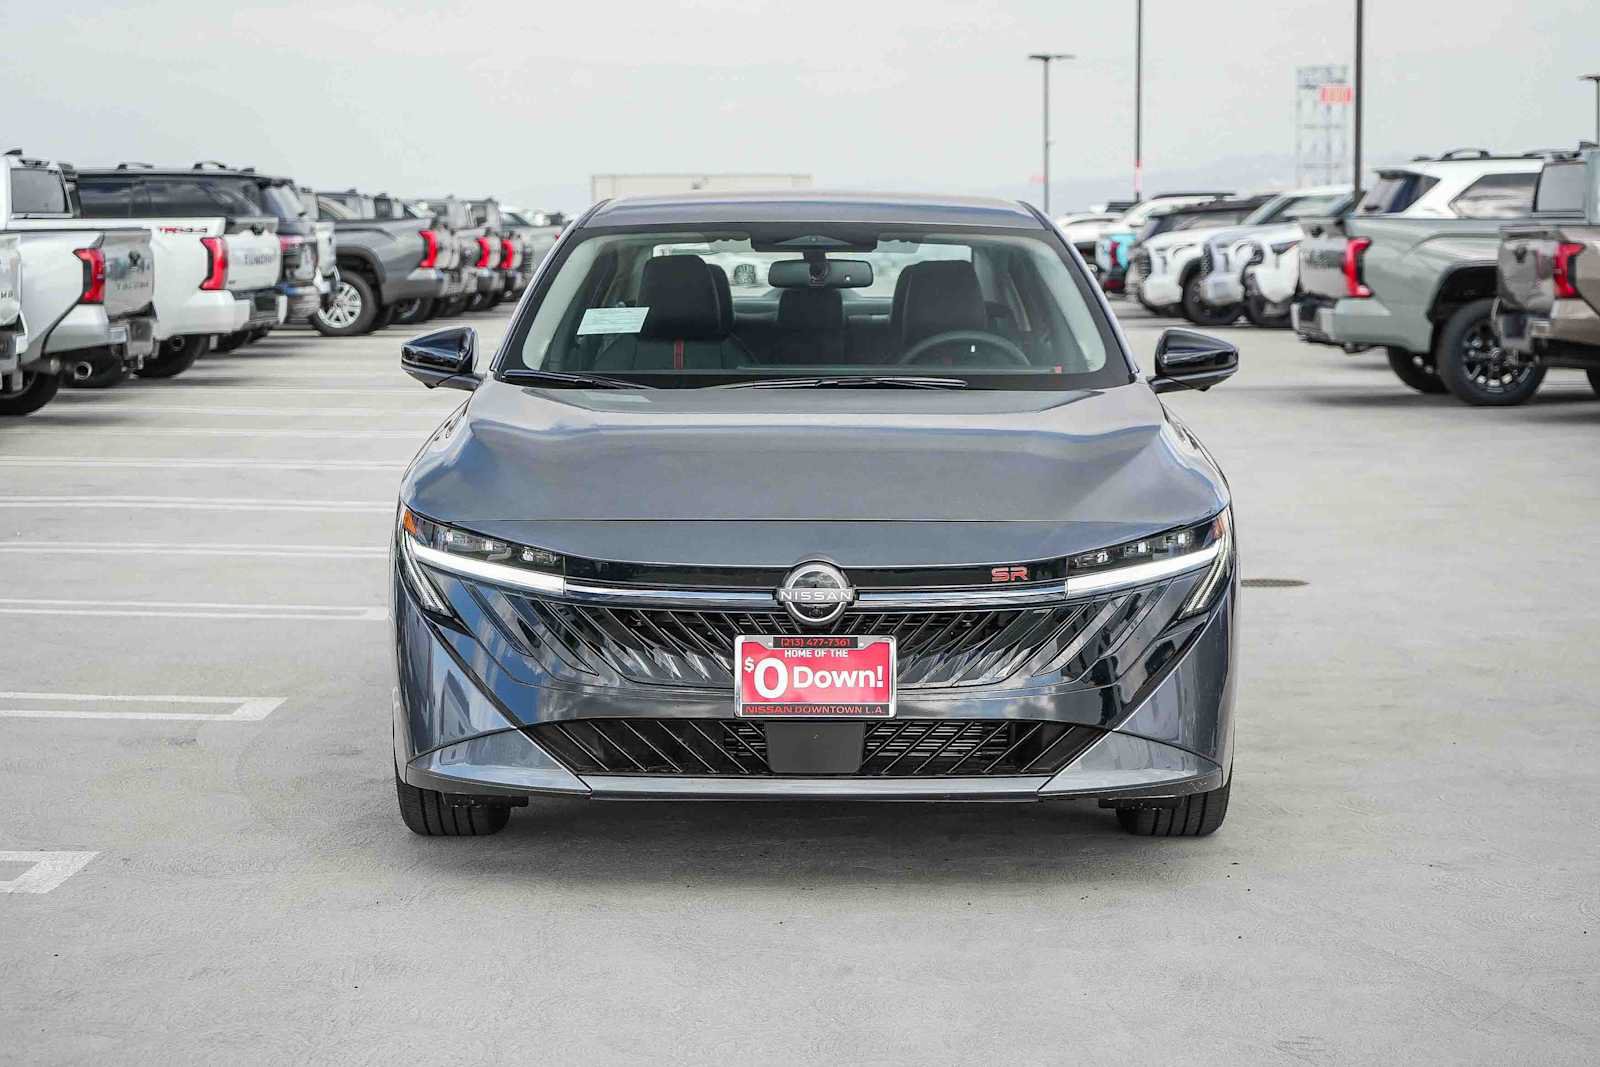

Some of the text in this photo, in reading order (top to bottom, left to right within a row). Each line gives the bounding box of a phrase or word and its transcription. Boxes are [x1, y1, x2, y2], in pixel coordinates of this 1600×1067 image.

[992, 567, 1028, 582] SR
[780, 591, 851, 601] NISSAN
[781, 638, 804, 647] (213)
[784, 649, 849, 658] HOME OF THE
[793, 665, 884, 689] Down!
[745, 705, 886, 714] NISSAN DOWNTOWN L.A.
